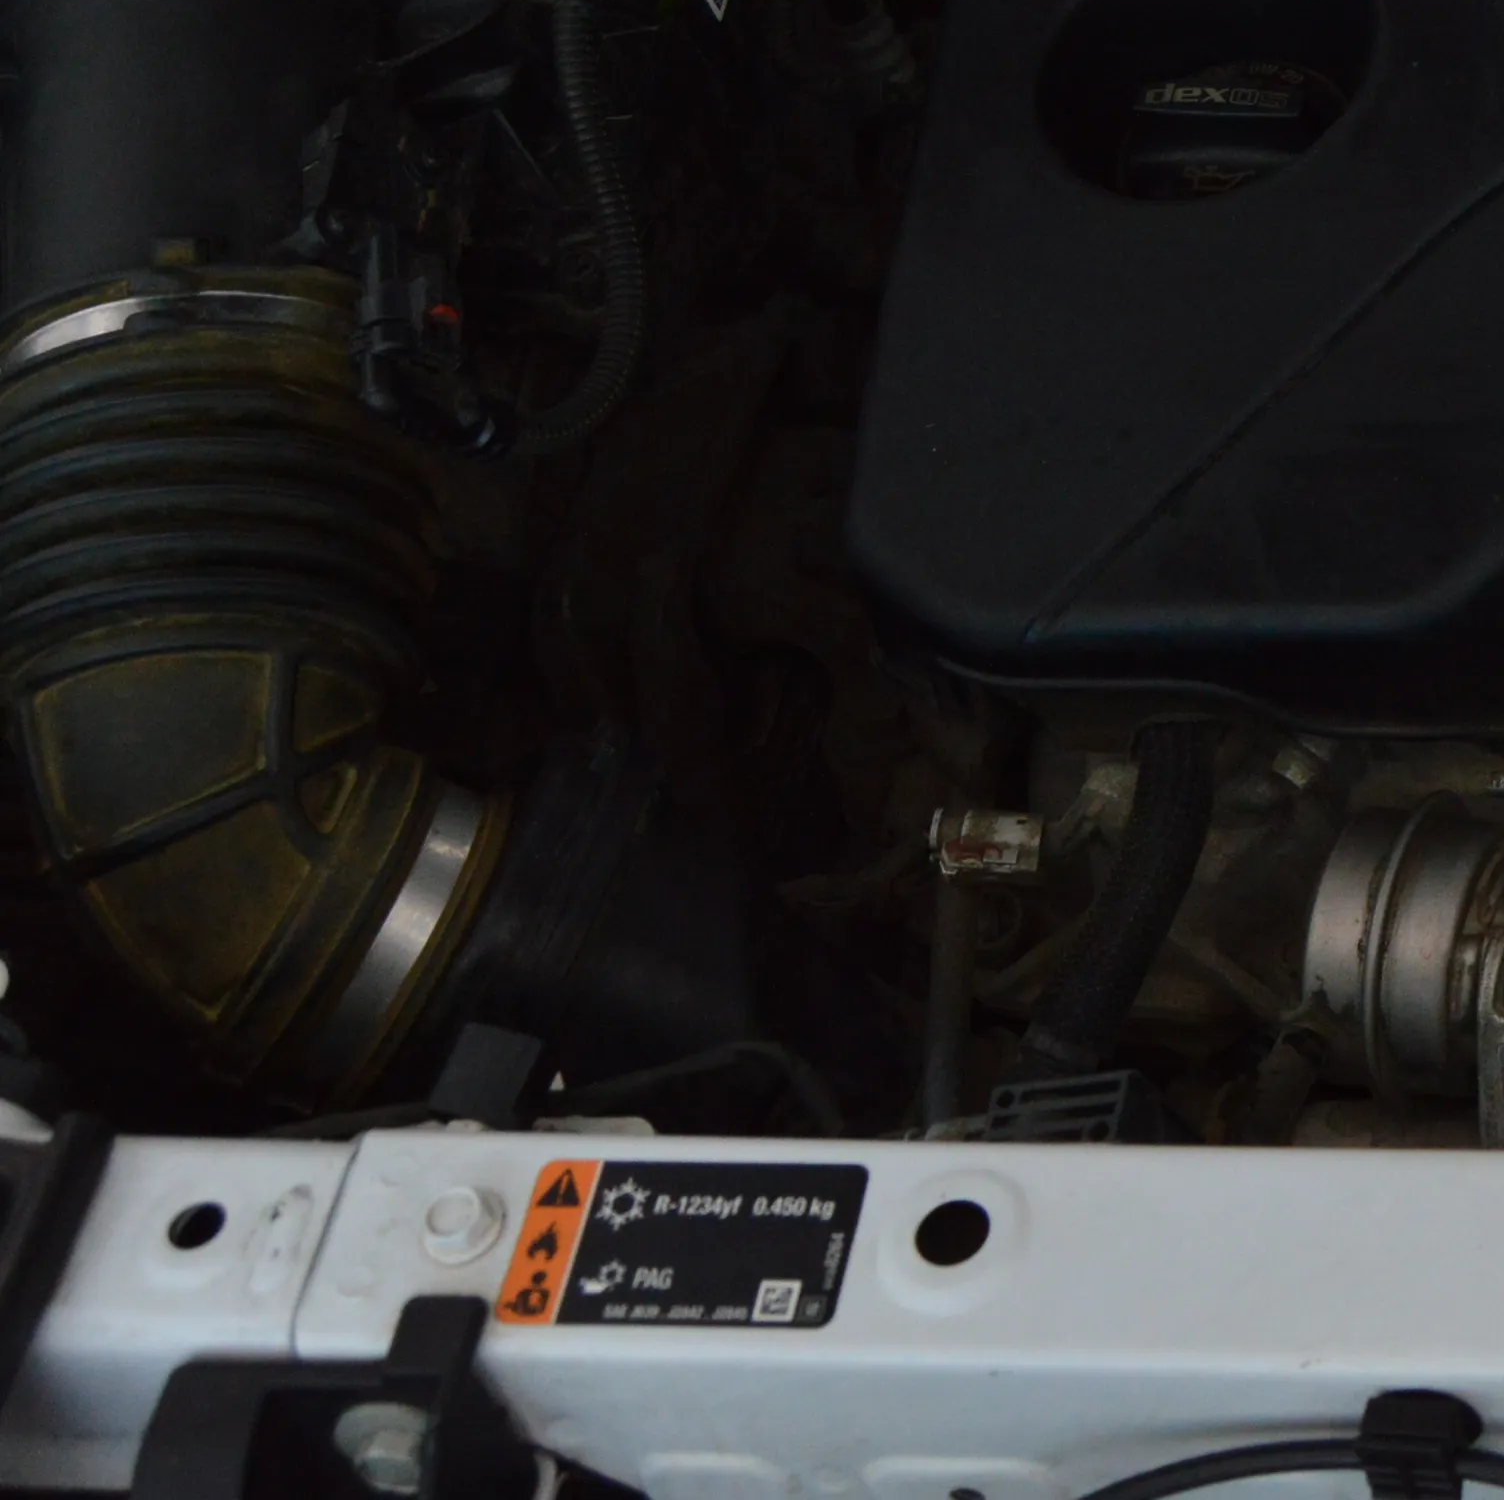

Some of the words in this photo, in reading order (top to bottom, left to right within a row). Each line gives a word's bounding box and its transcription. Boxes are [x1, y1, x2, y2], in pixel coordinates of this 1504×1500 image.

[1144, 82, 1290, 110] dexos
[653, 1193, 743, 1219] R-1234yf
[753, 1197, 807, 1217] 0.450
[807, 1198, 837, 1220] kg
[631, 1267, 675, 1290] PAG
